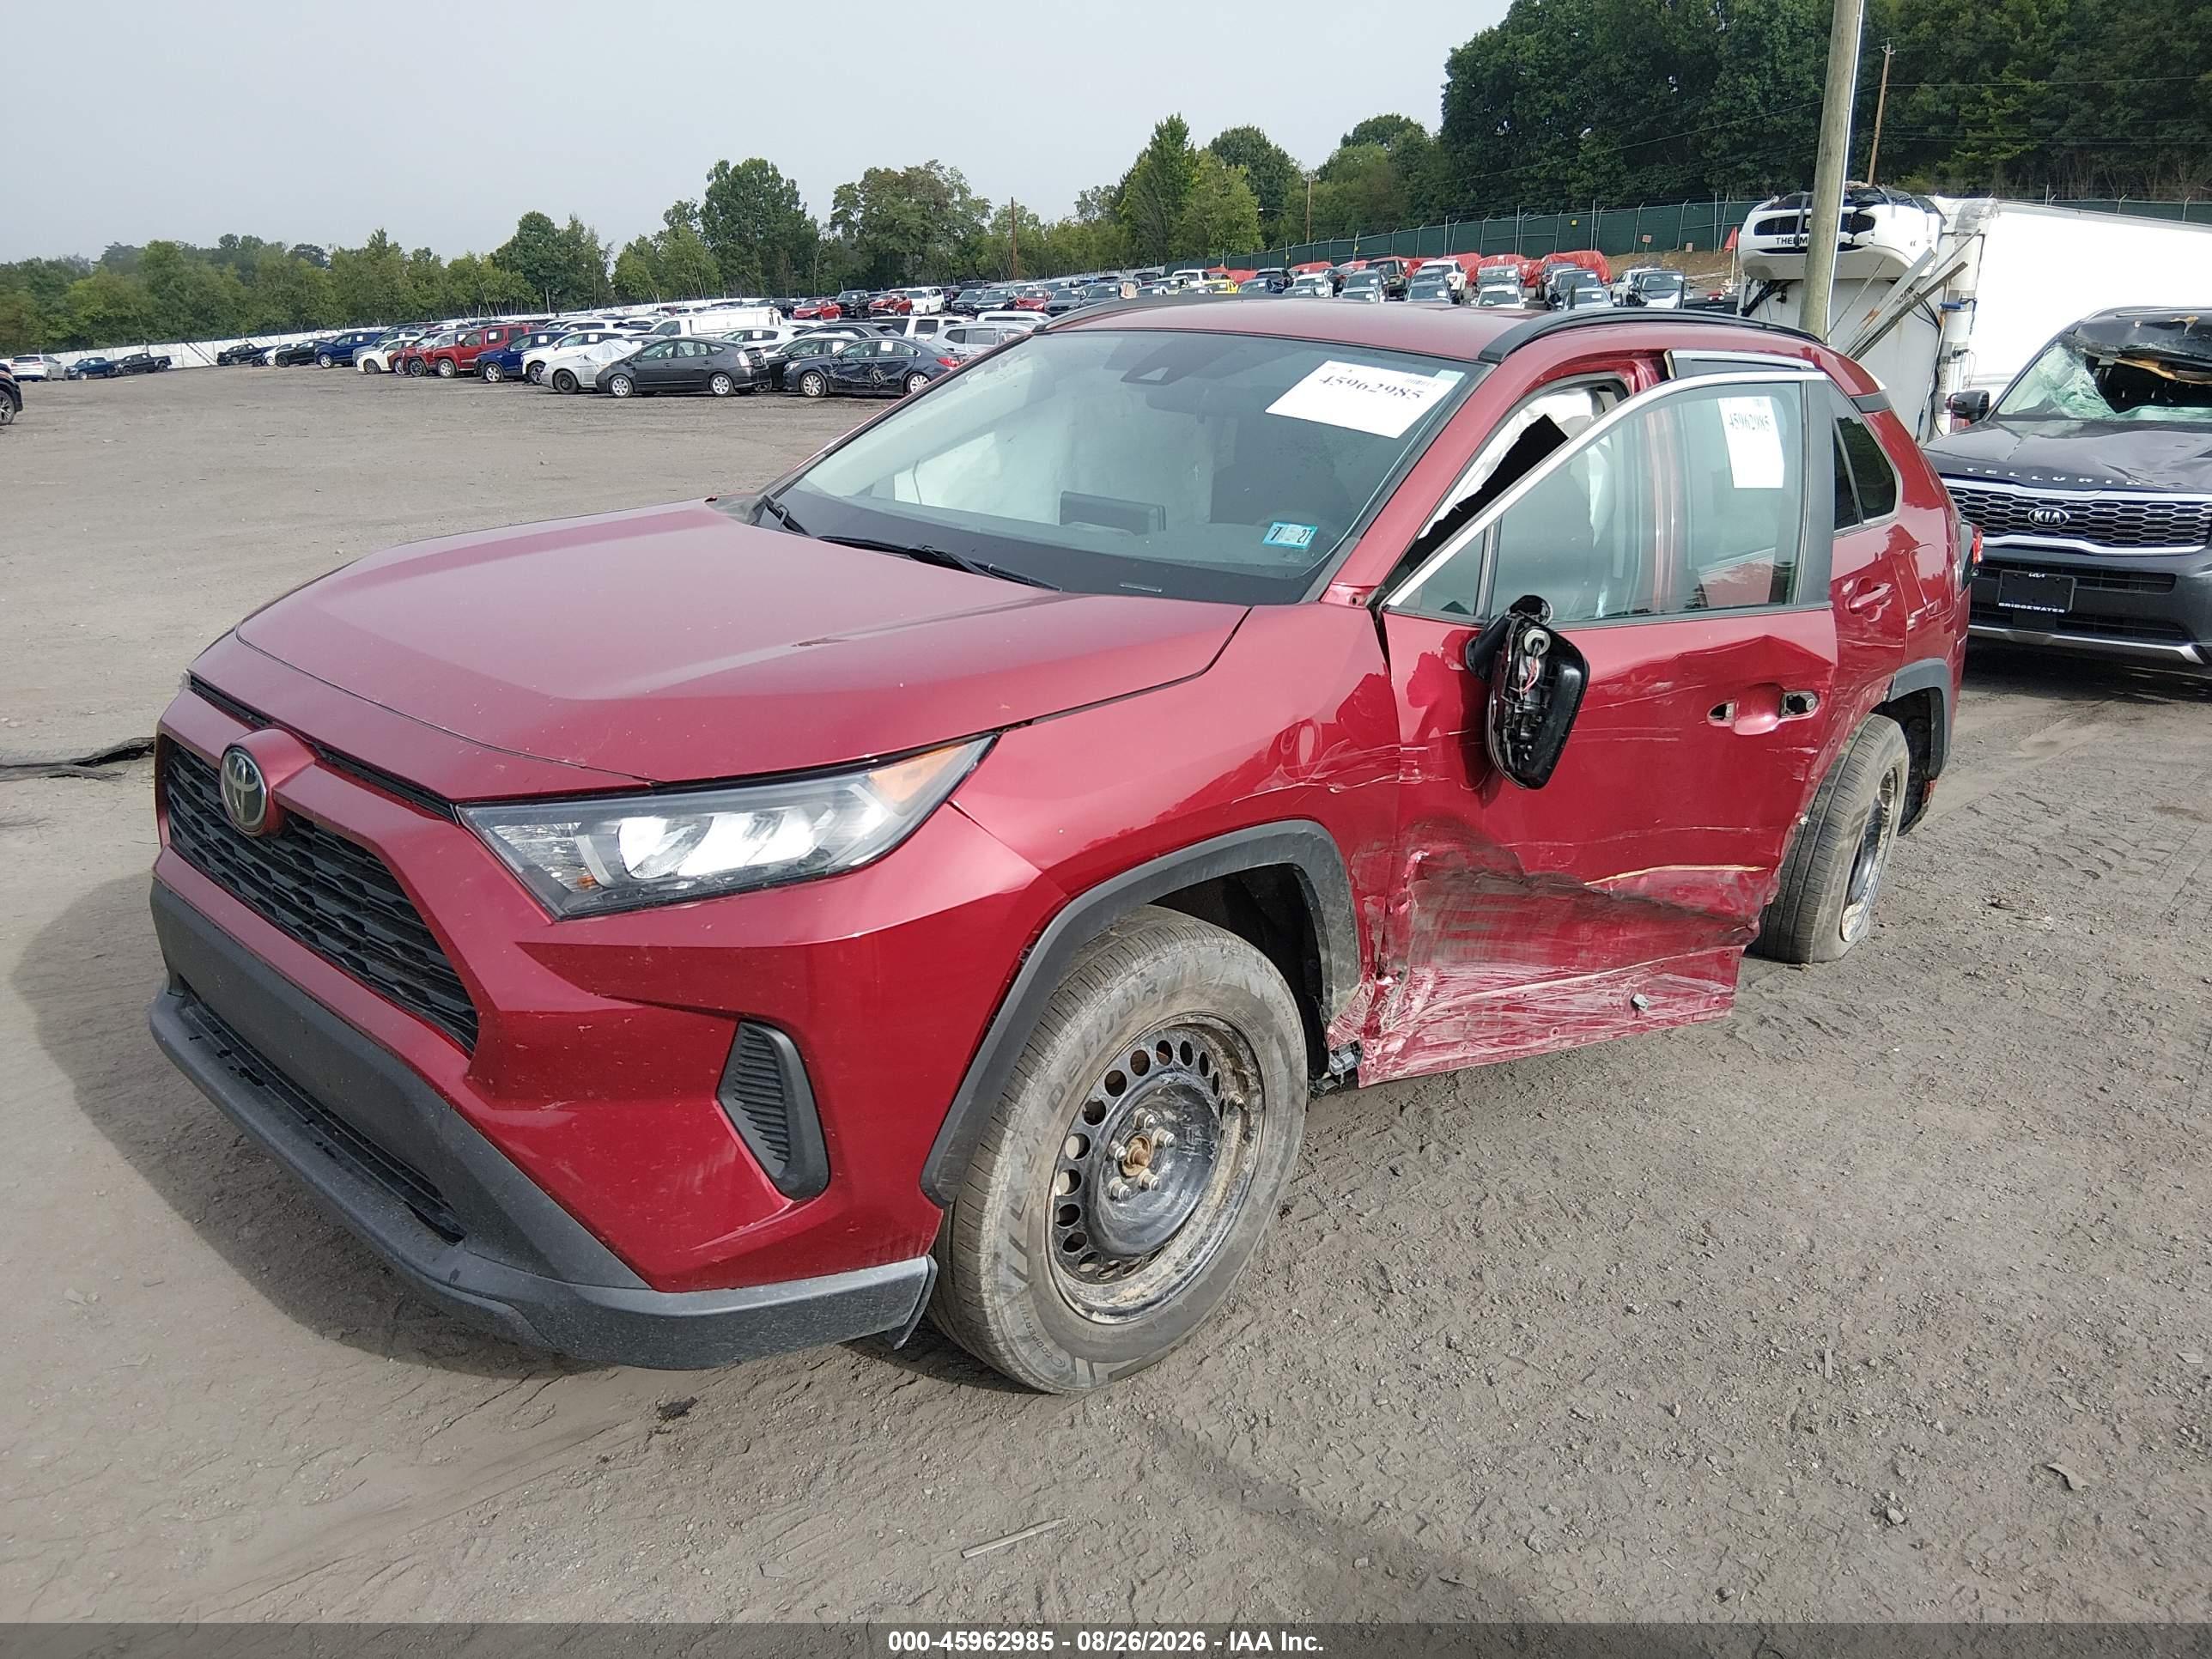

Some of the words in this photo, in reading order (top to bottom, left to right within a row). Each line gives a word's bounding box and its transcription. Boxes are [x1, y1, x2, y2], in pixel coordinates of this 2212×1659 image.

[1319, 374, 1425, 399] 45962985
[2033, 510, 2062, 523] KIA
[1270, 526, 1284, 541] 7
[1297, 528, 1313, 544] 27
[1998, 602, 2065, 614] BRIDGEWATER
